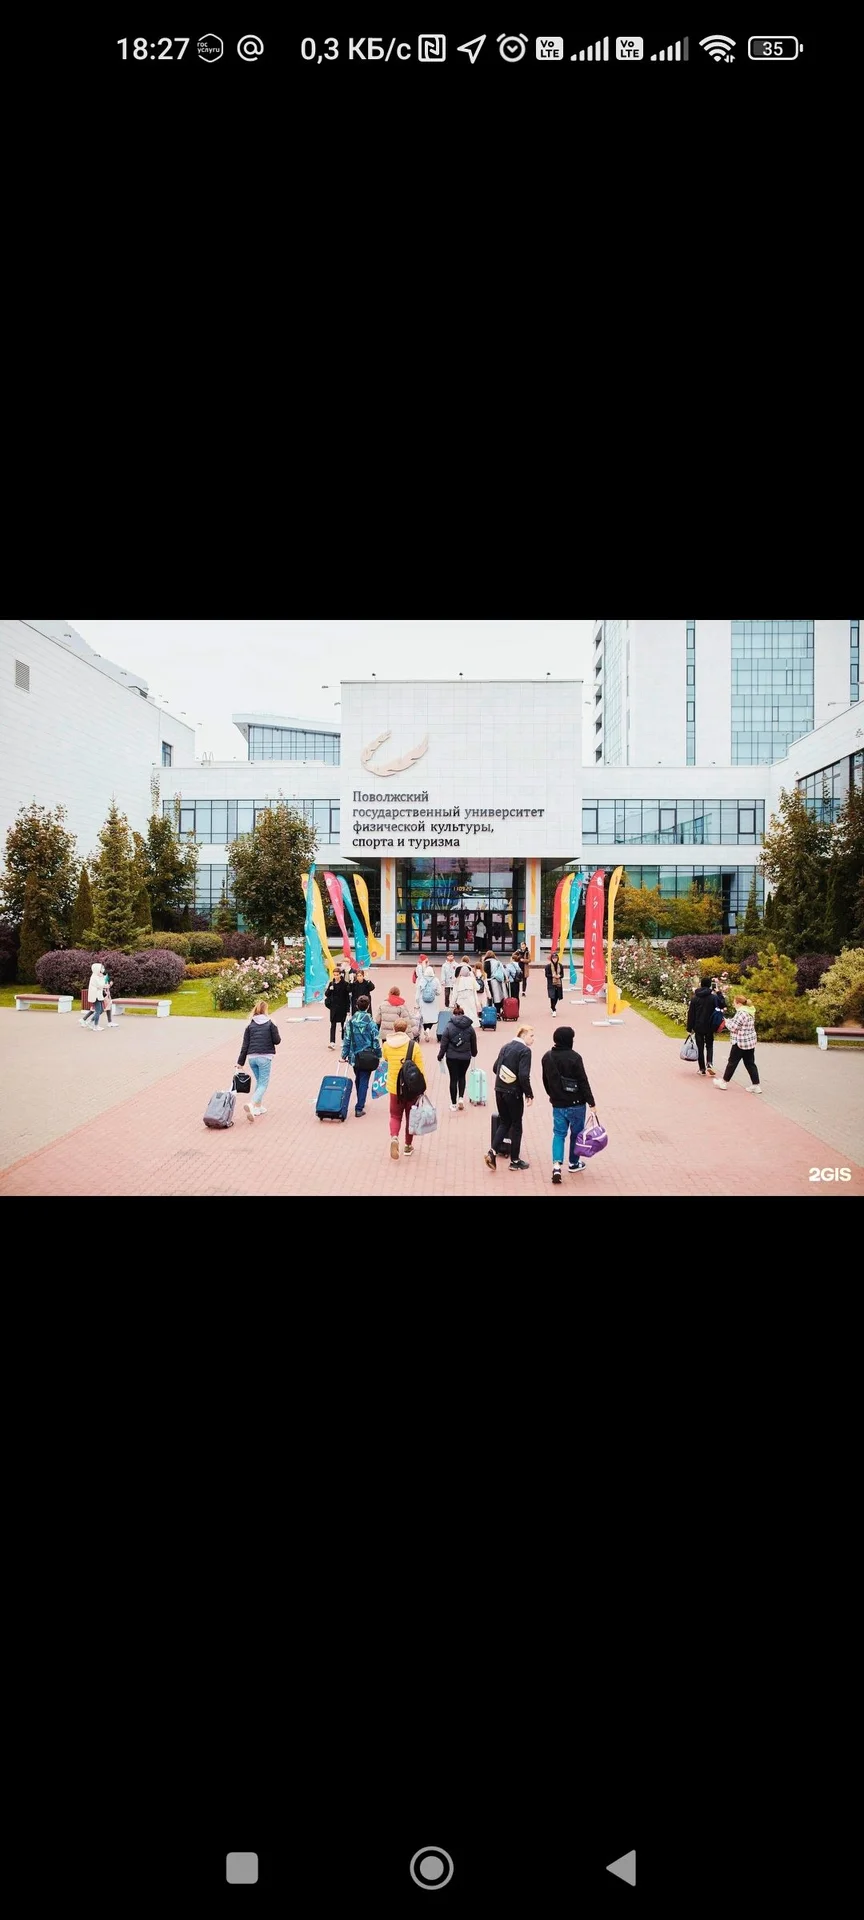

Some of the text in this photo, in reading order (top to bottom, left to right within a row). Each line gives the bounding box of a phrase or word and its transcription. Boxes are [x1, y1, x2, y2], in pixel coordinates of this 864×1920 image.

[117, 37, 190, 60] 18:27
[300, 37, 412, 64] 0,3 КБ/с
[540, 49, 560, 58] LTE
[620, 49, 640, 58] LTE
[762, 42, 783, 56] 35
[352, 791, 429, 802] Поволжский
[352, 806, 545, 819] государственный университет
[352, 821, 494, 834] физической культуры,
[352, 838, 461, 849] спорта и туризма
